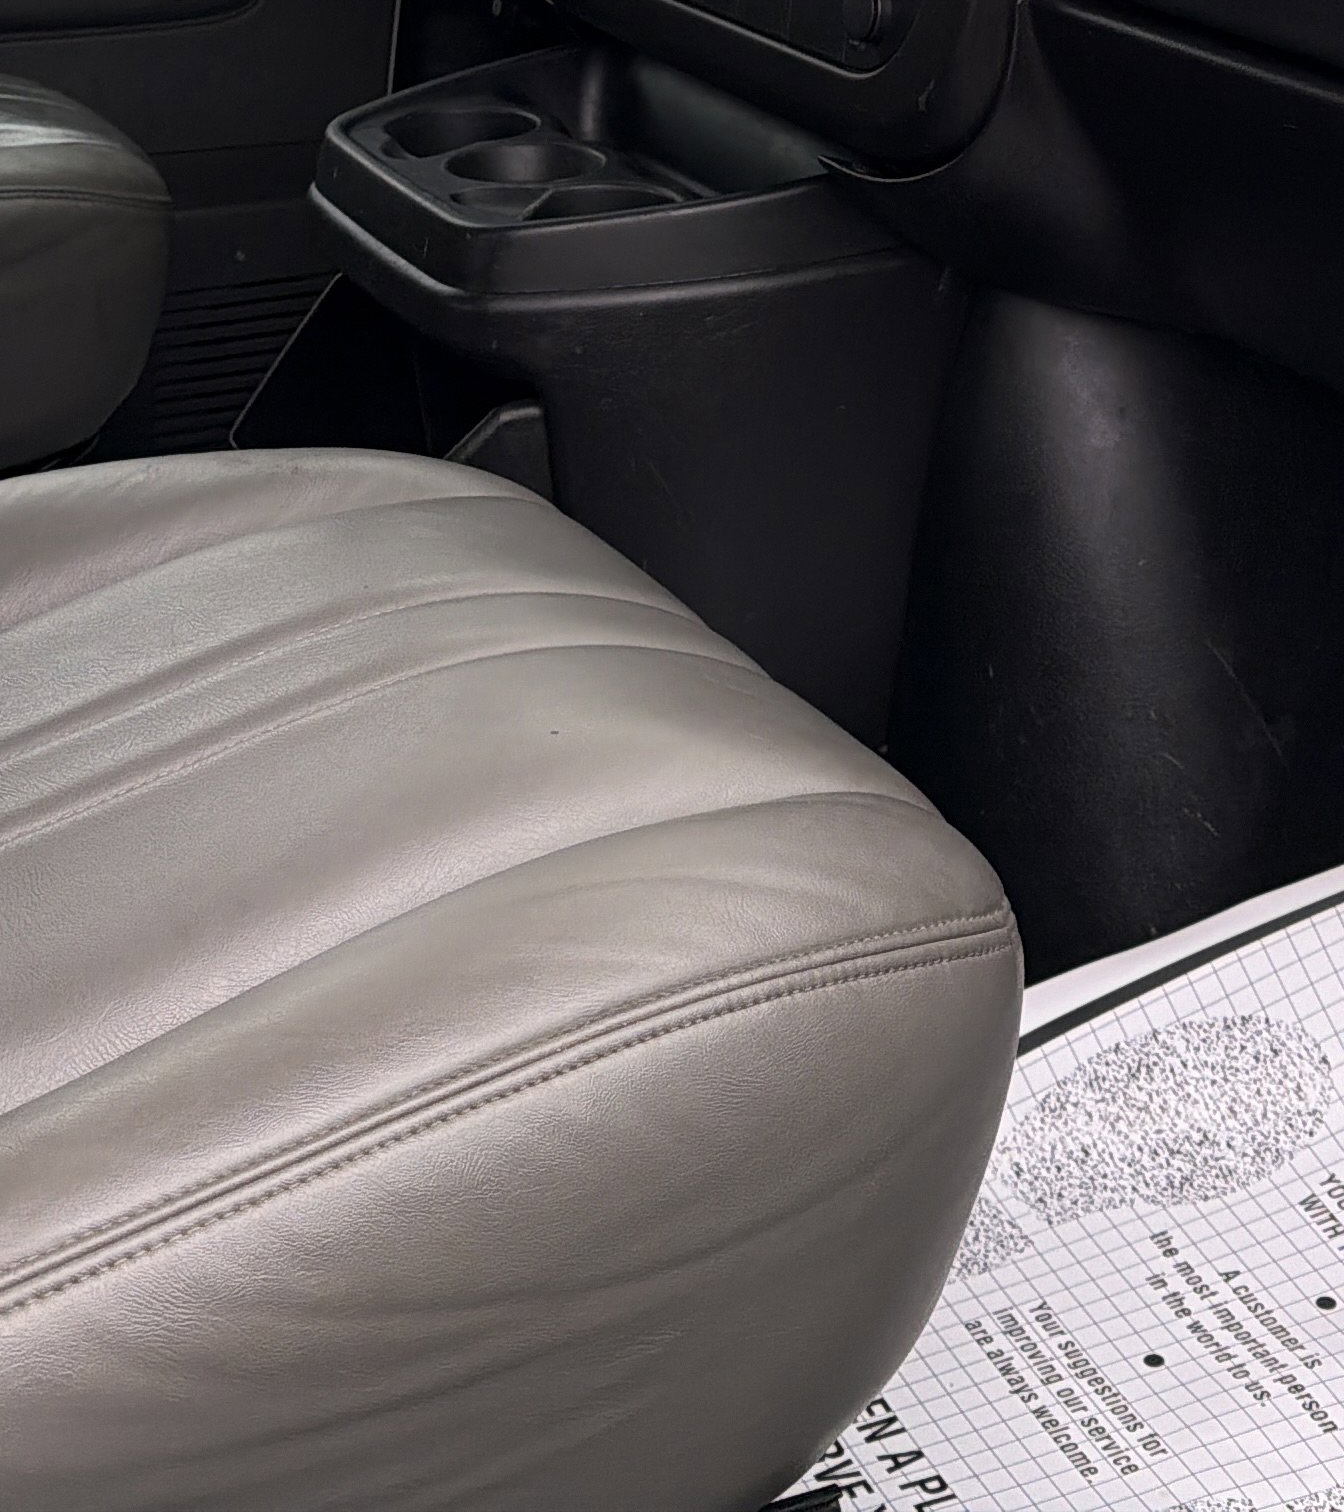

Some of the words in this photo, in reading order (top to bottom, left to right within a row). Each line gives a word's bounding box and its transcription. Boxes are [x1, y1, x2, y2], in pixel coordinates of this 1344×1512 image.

[992, 1307, 1065, 1385] improving
[1056, 1387, 1089, 1414] our
[1080, 1417, 1140, 1476] service
[1029, 1301, 1067, 1338] Your
[1057, 1340, 1145, 1433] suggestions
[1137, 1432, 1169, 1458] for
[1145, 1272, 1169, 1291] in
[1161, 1291, 1192, 1319] the
[1186, 1320, 1239, 1363] world
[1227, 1363, 1251, 1379] to
[1245, 1381, 1272, 1407] us.
[1149, 1230, 1180, 1258] the
[1173, 1261, 1219, 1301] most
[1209, 1301, 1288, 1373] important
[1273, 1374, 1339, 1434] person
[1218, 1270, 1241, 1284] A
[1232, 1285, 1307, 1353] customer
[1300, 1353, 1323, 1370] is
[876, 1450, 924, 1474] A
[964, 1320, 994, 1346] are
[986, 1348, 1040, 1404] always
[1032, 1404, 1099, 1485] welcome.
